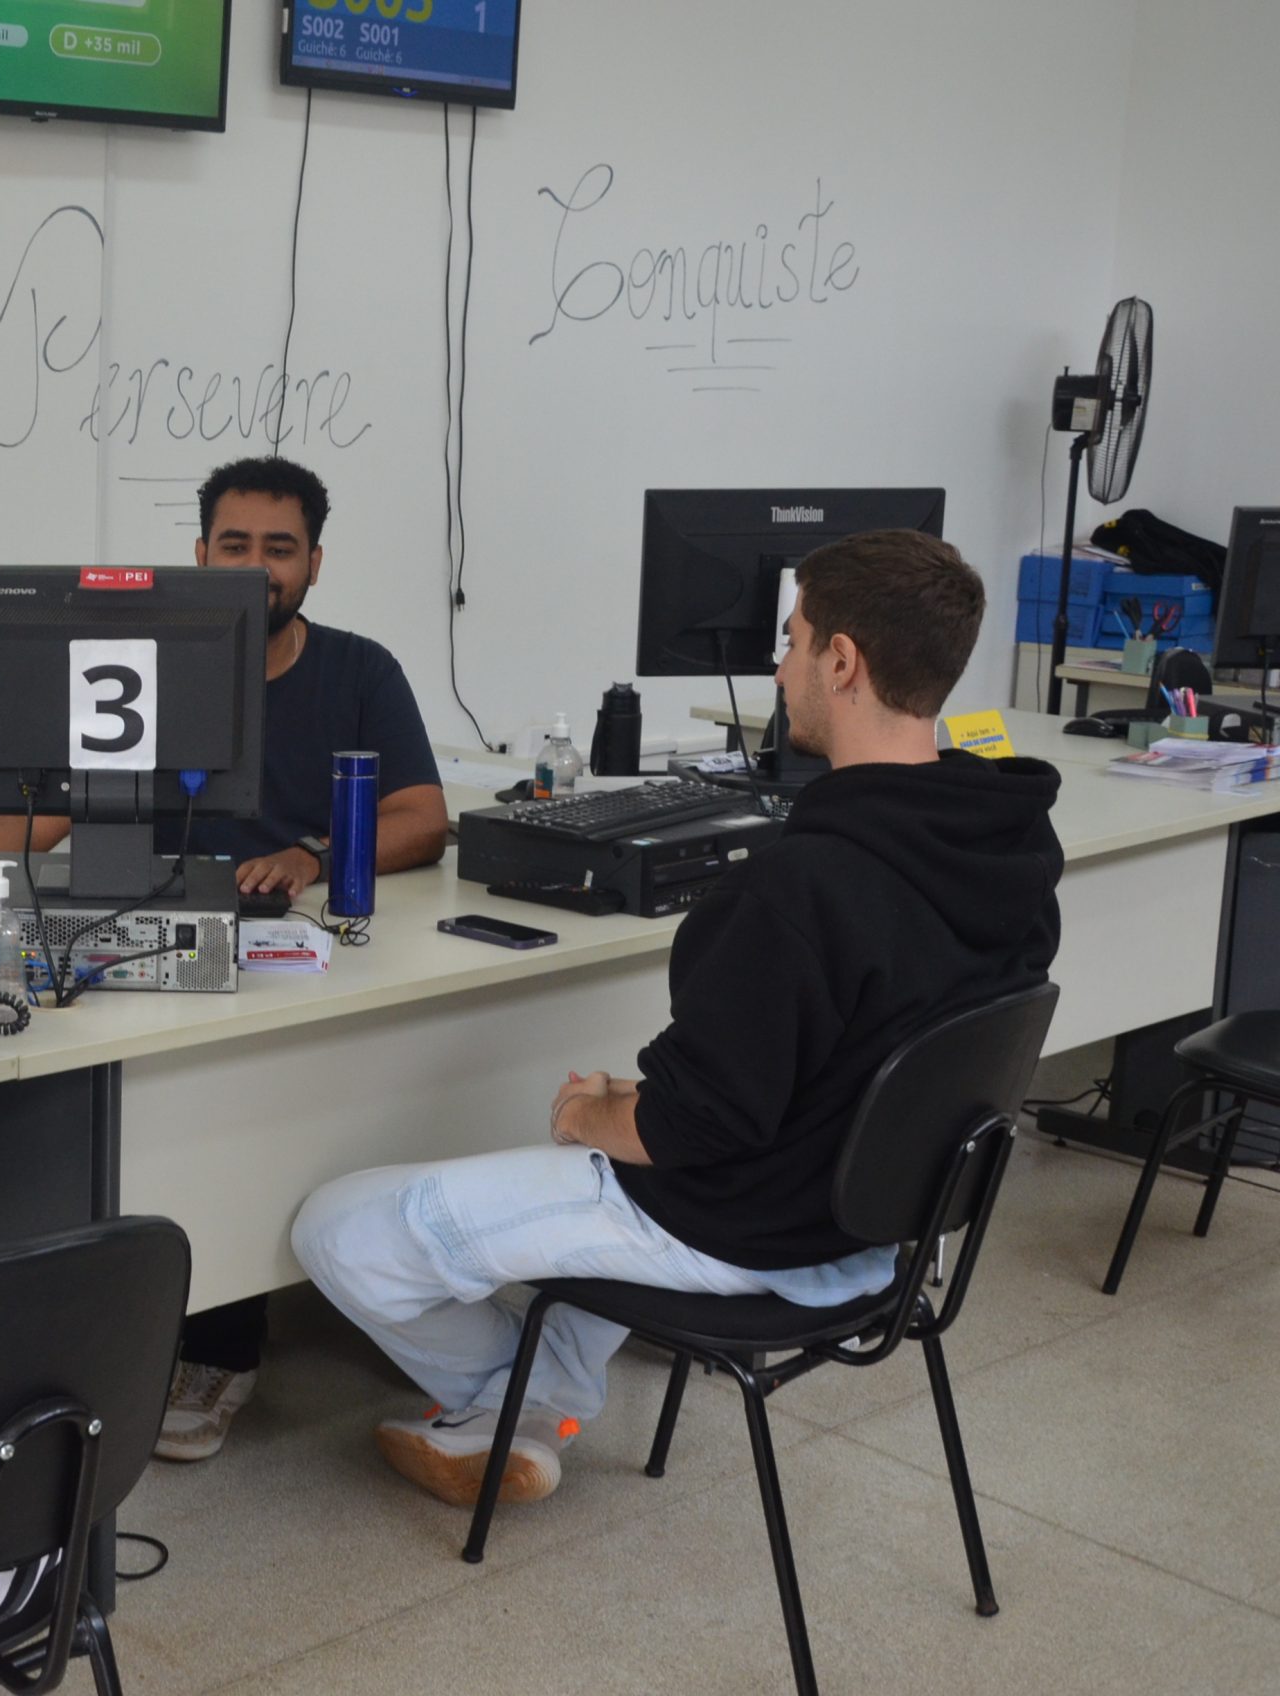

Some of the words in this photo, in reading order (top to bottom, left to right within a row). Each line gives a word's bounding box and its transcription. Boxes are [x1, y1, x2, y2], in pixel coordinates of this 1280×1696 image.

[302, 15, 344, 39] S002
[360, 22, 399, 46] S001
[474, 1, 487, 33] 1
[64, 31, 78, 50] D
[84, 35, 112, 52] +35
[117, 38, 141, 56] mil
[529, 163, 860, 364] Conquiste
[770, 506, 824, 523] ThinkVision
[125, 572, 148, 582] PEI
[81, 664, 145, 753] 3
